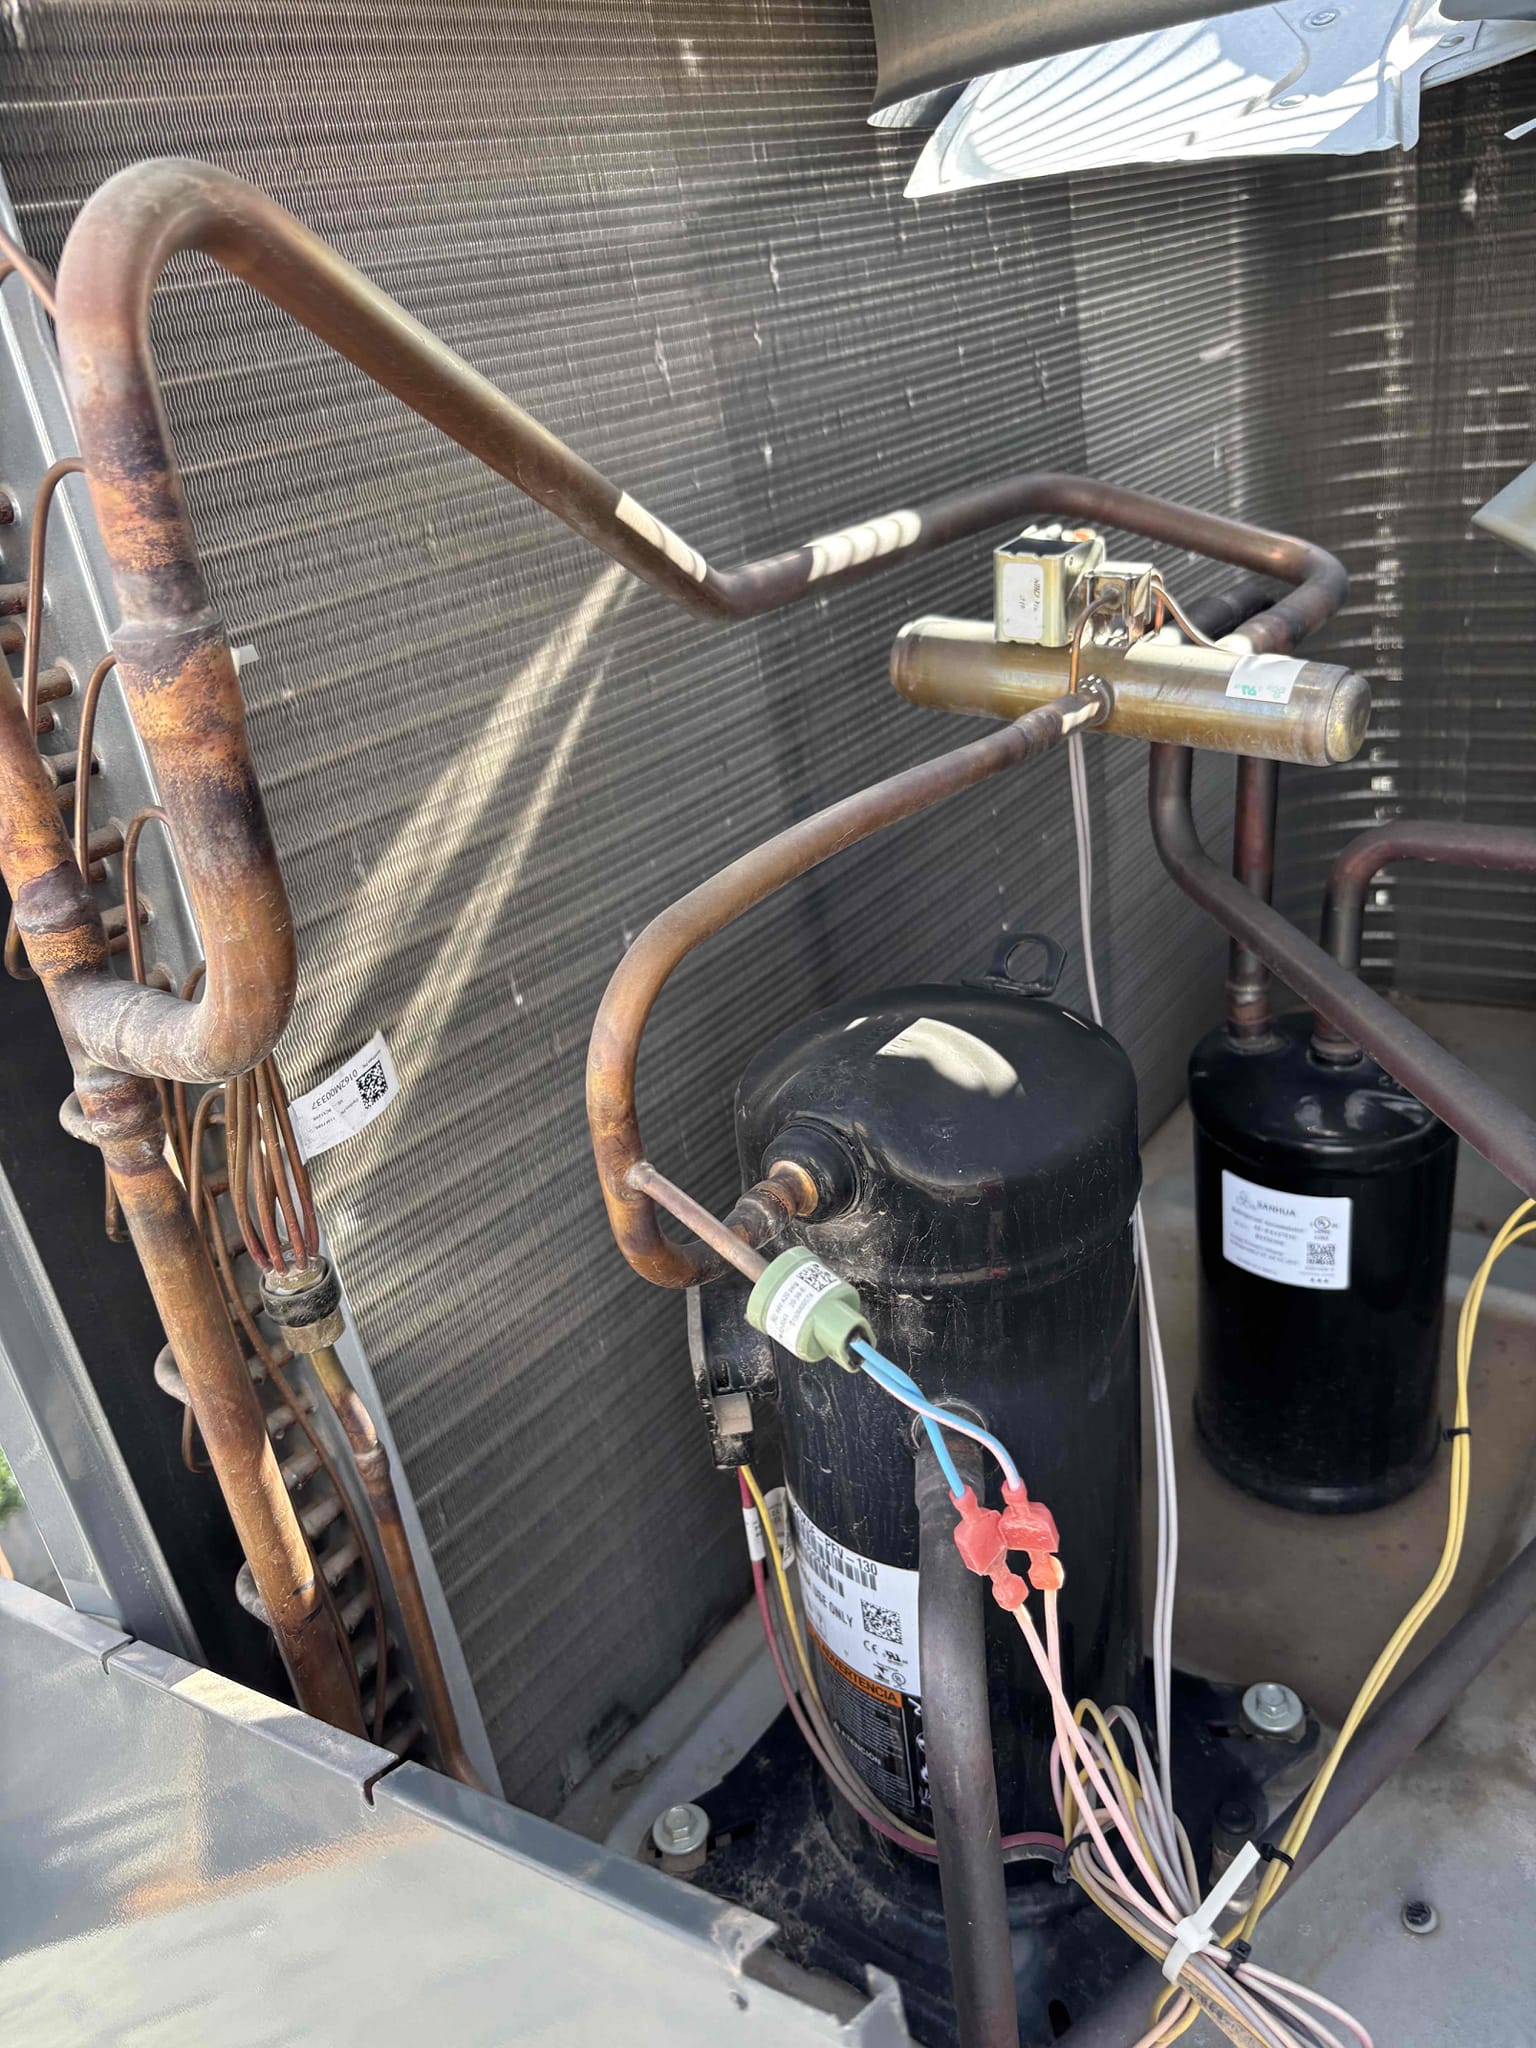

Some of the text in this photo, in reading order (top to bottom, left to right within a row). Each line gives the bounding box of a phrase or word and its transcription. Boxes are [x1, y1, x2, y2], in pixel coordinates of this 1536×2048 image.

[311, 1069, 358, 1110] 0162M00337
[1256, 1201, 1296, 1217] SANHUA
[828, 1601, 853, 1629] ONLY
